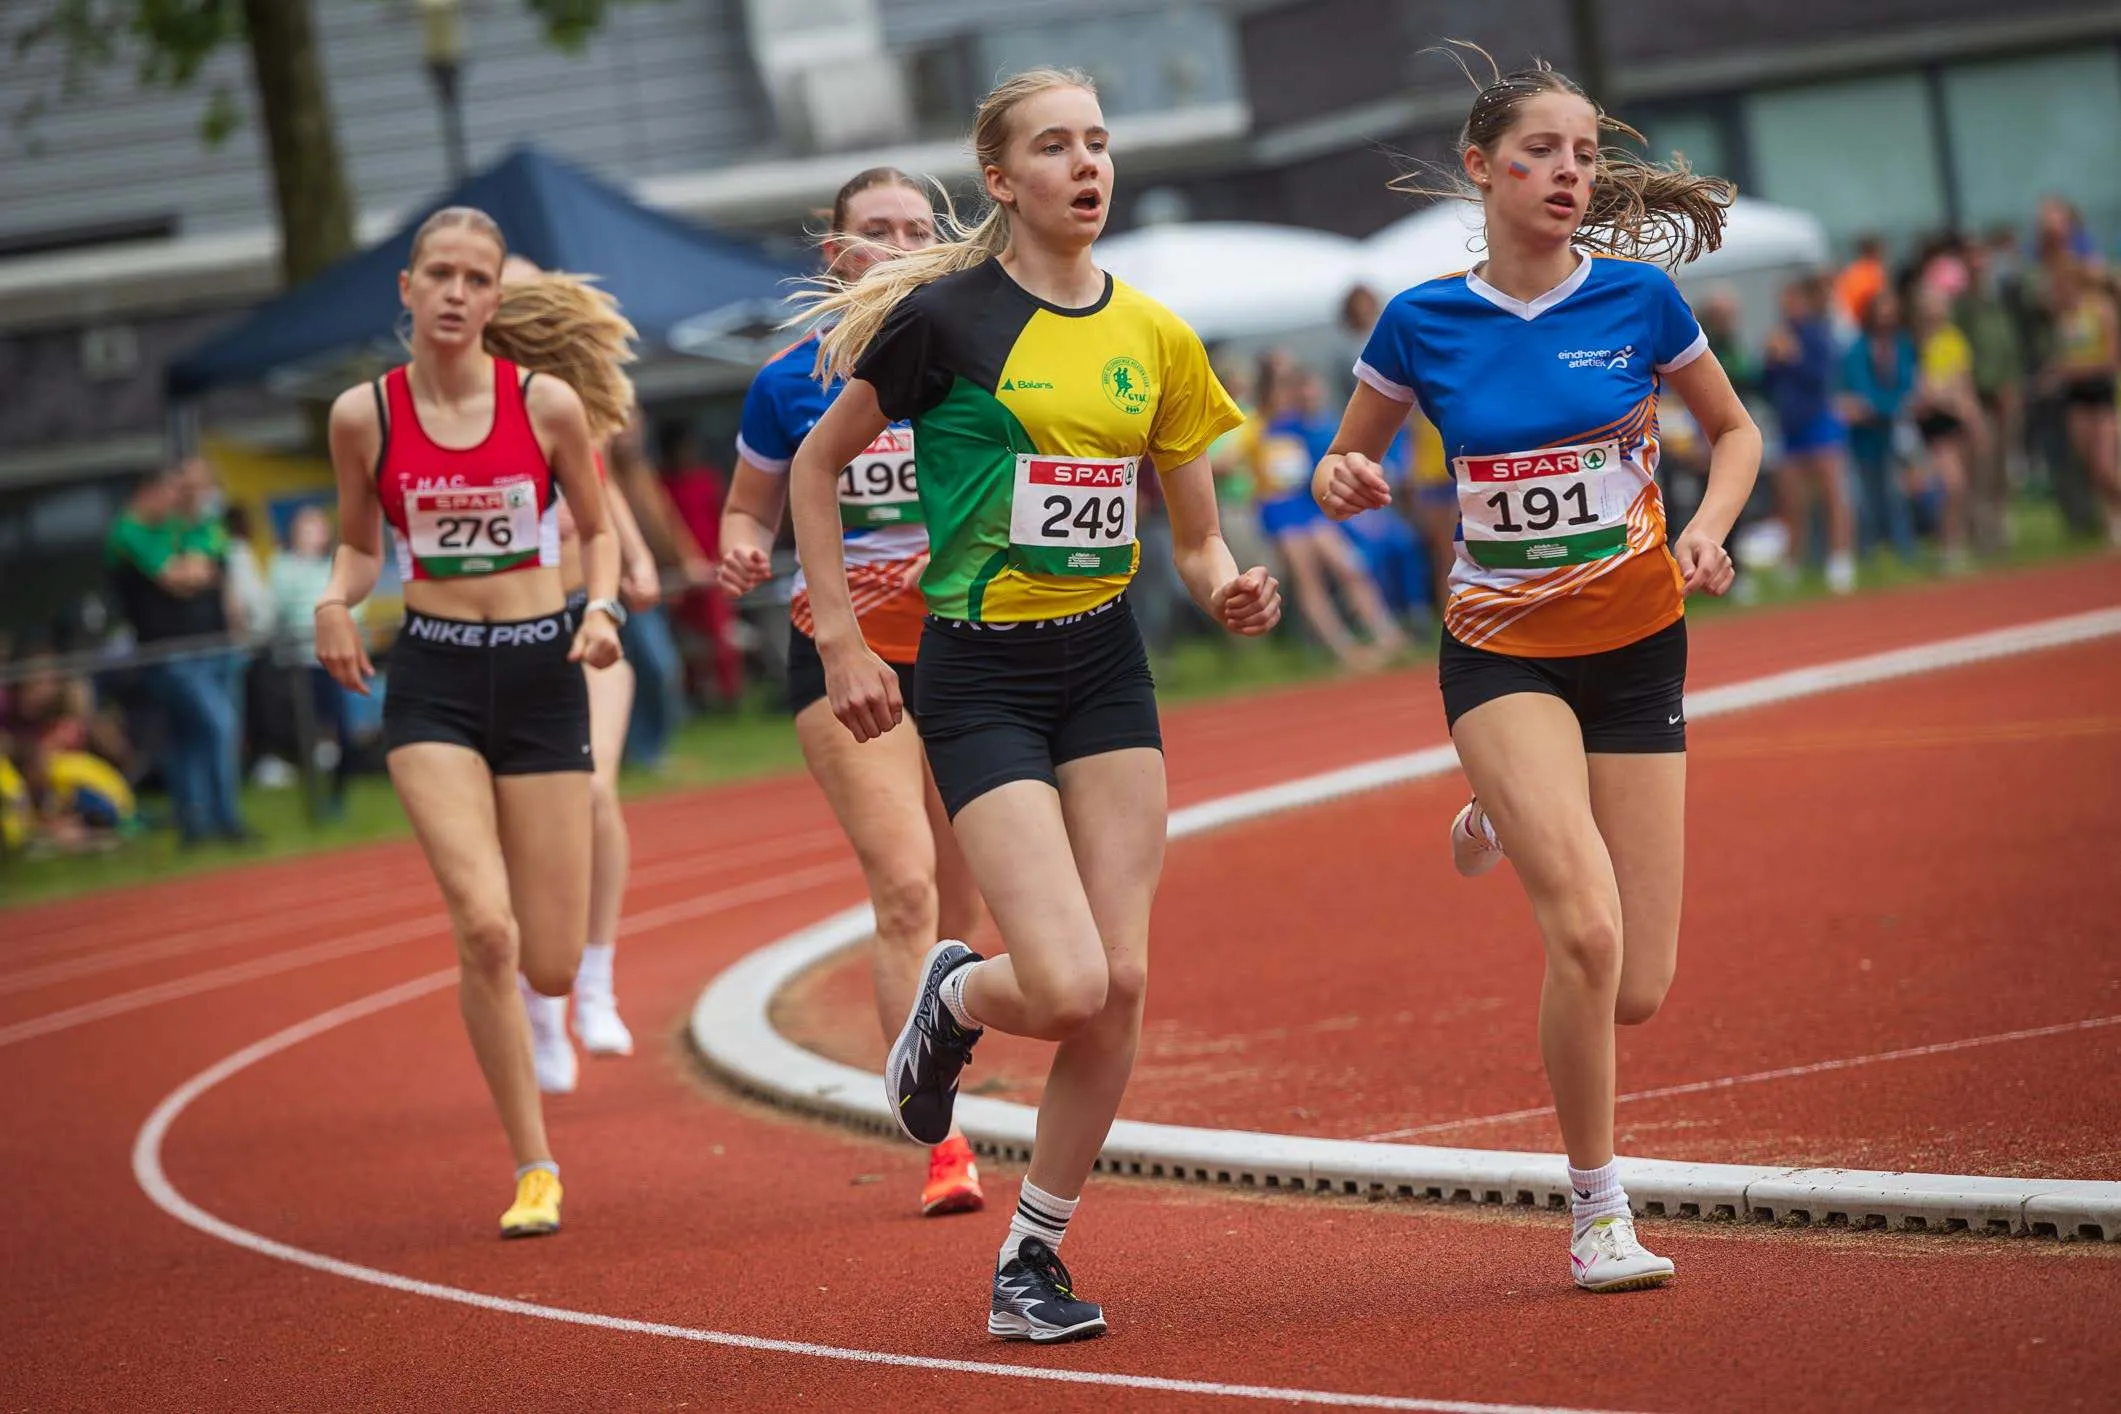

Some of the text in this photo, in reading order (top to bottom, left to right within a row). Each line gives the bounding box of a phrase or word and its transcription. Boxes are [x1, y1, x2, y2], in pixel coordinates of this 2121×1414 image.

[1558, 349, 1612, 360] eindhoven
[1017, 380, 1054, 389] Balans
[840, 460, 919, 497] 196
[1054, 465, 1124, 484] SPAR
[1492, 455, 1578, 479] SPAR
[435, 494, 503, 509] SPAR
[1486, 481, 1600, 533] 191
[1041, 495, 1125, 540] 249
[436, 515, 513, 549] 276
[409, 616, 560, 648] NIKE PRO
